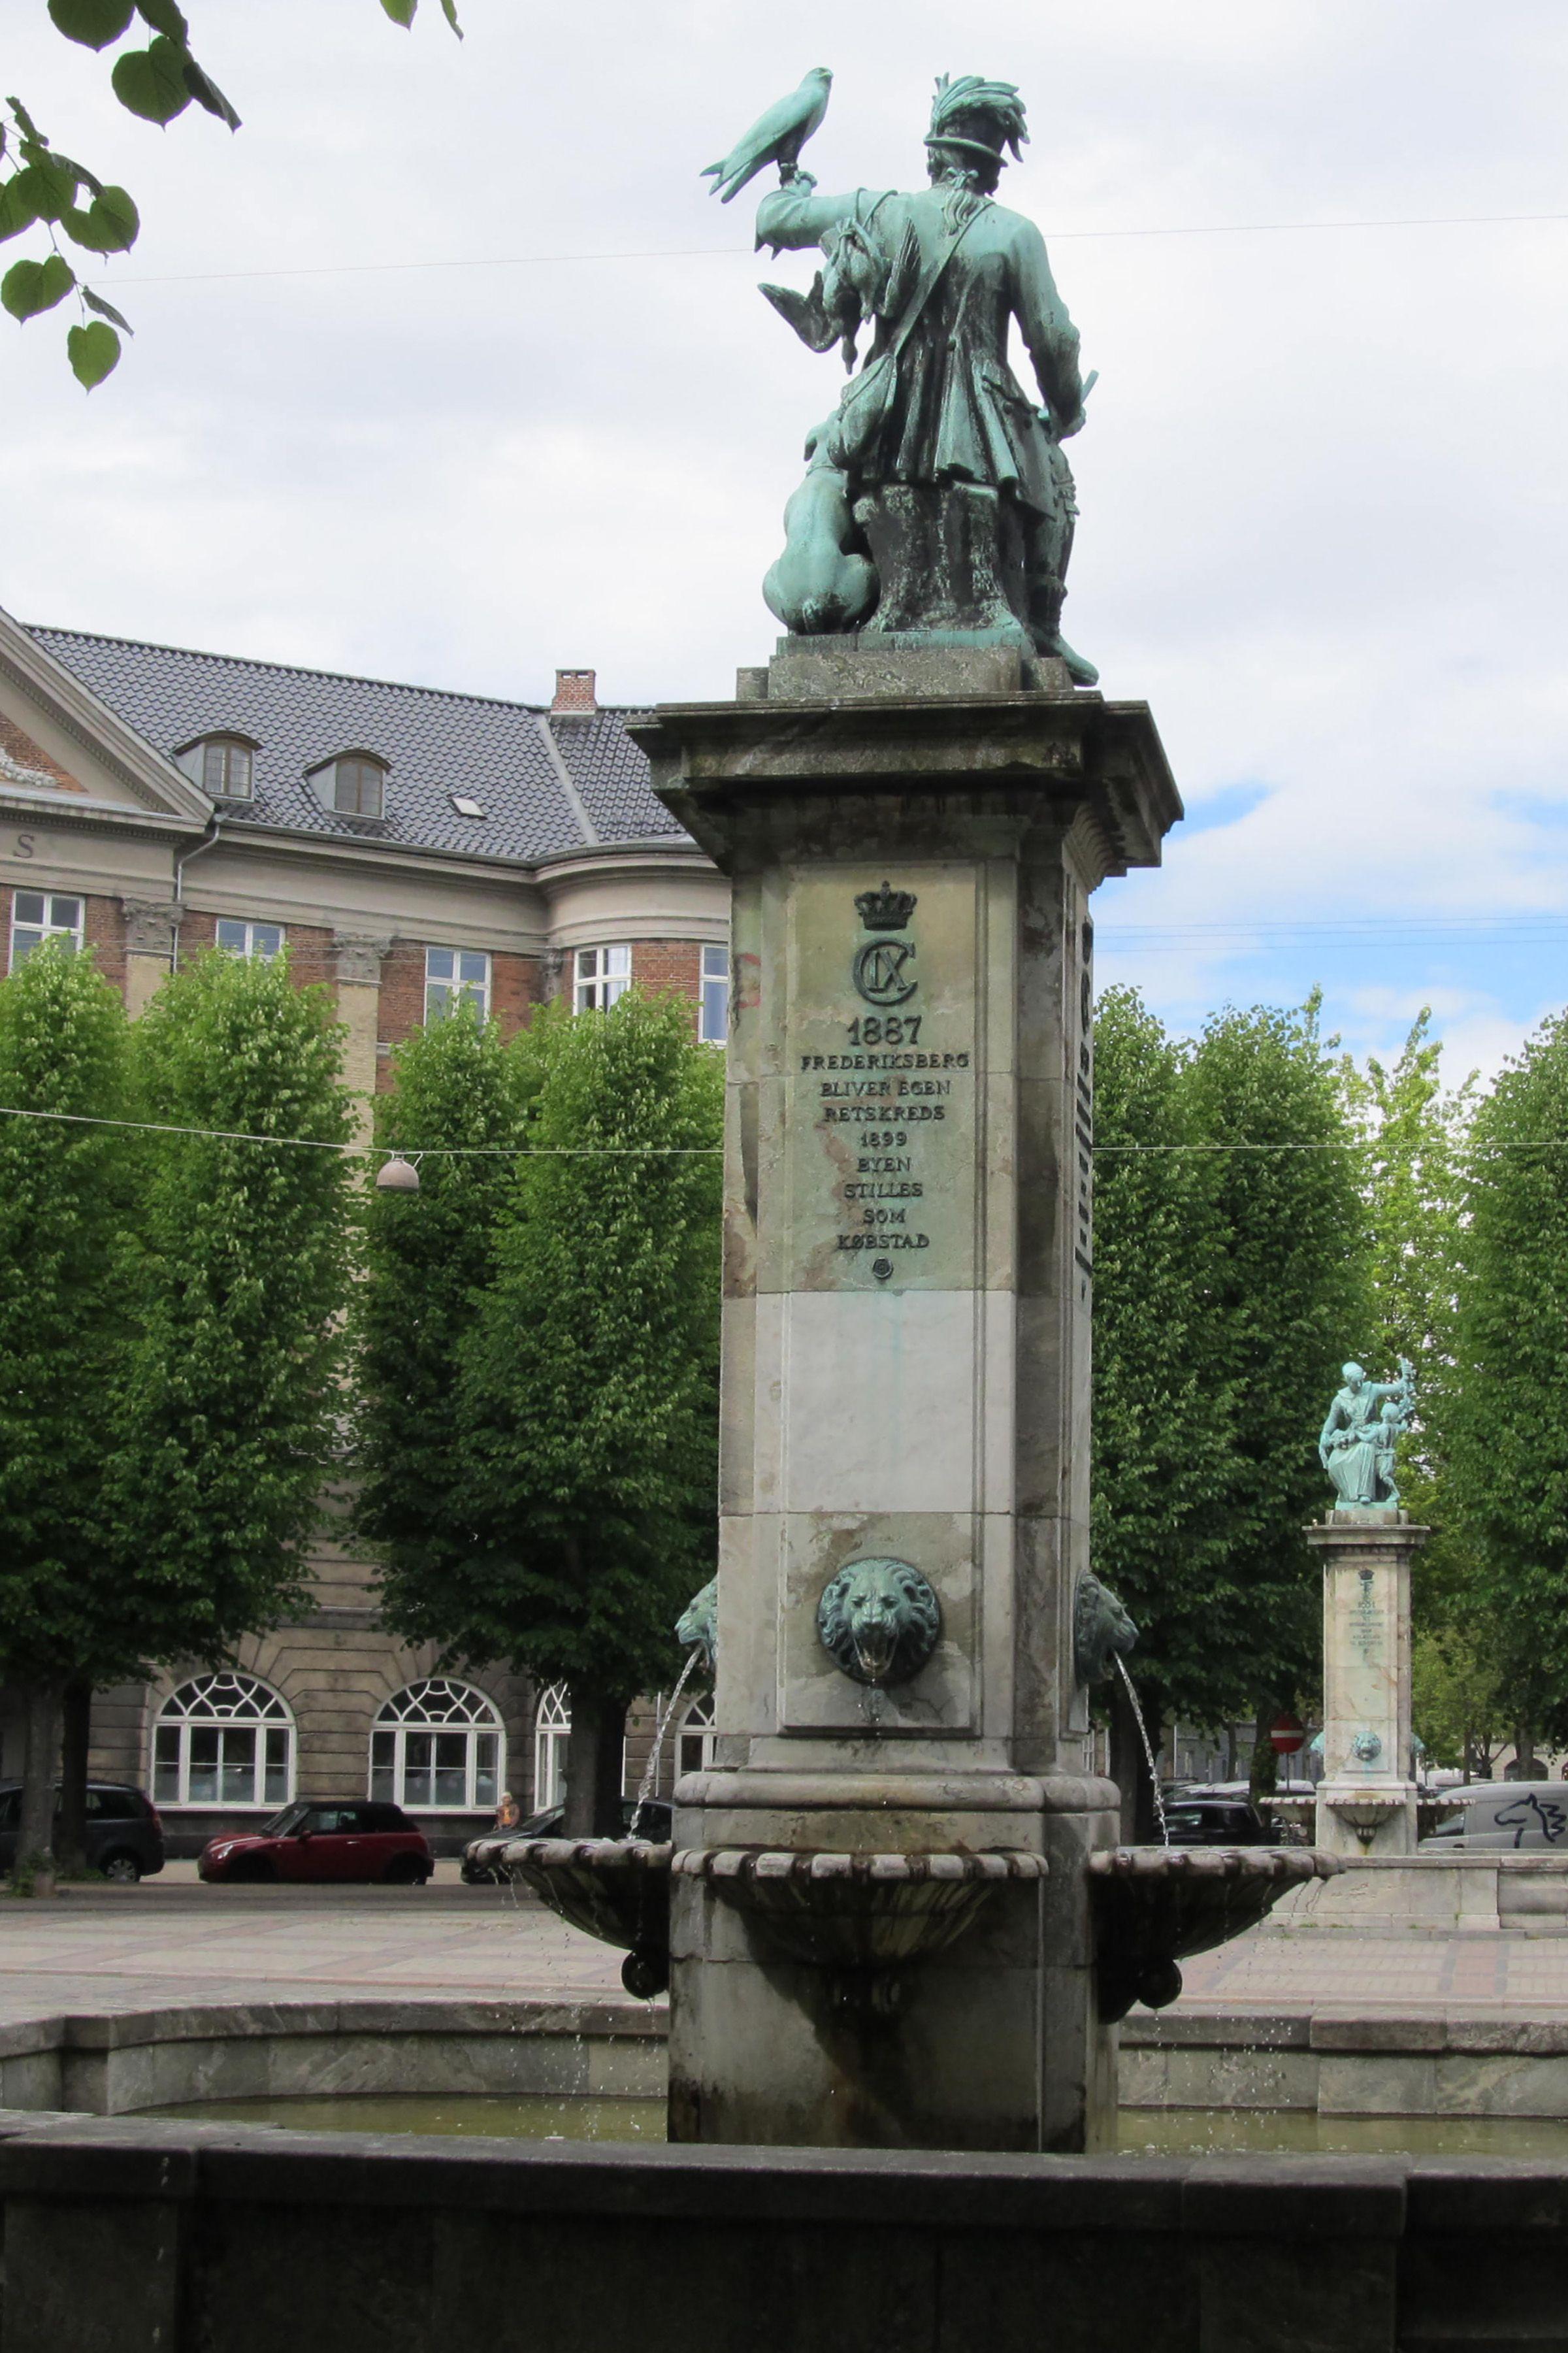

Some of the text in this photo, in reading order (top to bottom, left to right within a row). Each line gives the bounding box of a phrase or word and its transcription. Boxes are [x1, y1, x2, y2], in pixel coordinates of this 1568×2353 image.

[13, 834, 34, 859] S
[847, 1015, 922, 1046] 1887
[800, 1052, 970, 1070] FREDERIKSBERG
[820, 1080, 951, 1096] BLIVER EGEN
[823, 1106, 945, 1122] RETSKREDS
[860, 1131, 907, 1147] 1899
[857, 1157, 911, 1173] BYEN
[843, 1183, 923, 1198] STILLES
[862, 1209, 906, 1224] SOM
[836, 1234, 930, 1251] KØBSTAD
